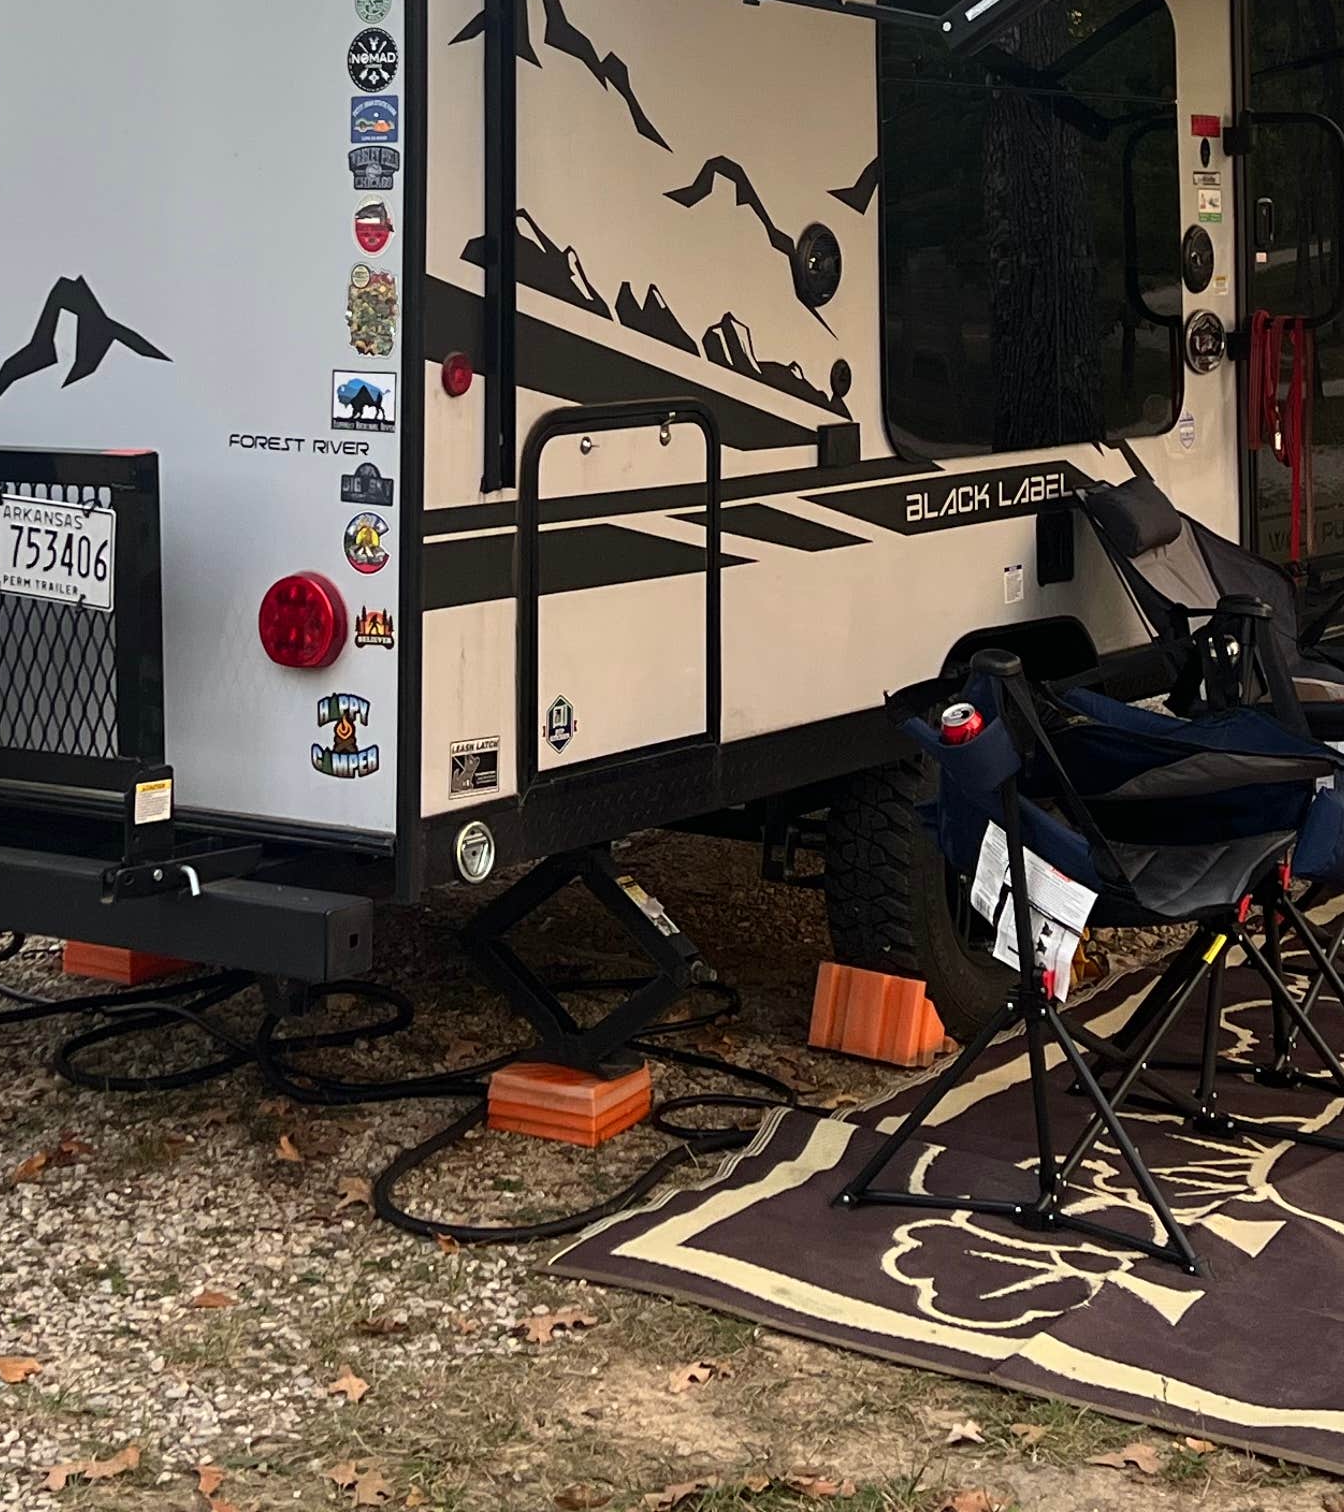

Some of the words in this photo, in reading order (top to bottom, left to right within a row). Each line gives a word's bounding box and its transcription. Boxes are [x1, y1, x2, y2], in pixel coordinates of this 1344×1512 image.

[350, 51, 397, 65] NOMAD
[229, 433, 305, 452] FOREST
[312, 439, 370, 456] RIVER
[905, 482, 990, 522] BLACK
[998, 473, 1074, 507] LABEL
[2, 504, 84, 530] ARKANSAS
[9, 525, 109, 582] 753406
[2, 575, 32, 591] PERM
[35, 579, 79, 596] TRAILER
[318, 693, 371, 727] HAPPY
[311, 743, 379, 779] CAMPER
[452, 743, 475, 755] LEASH
